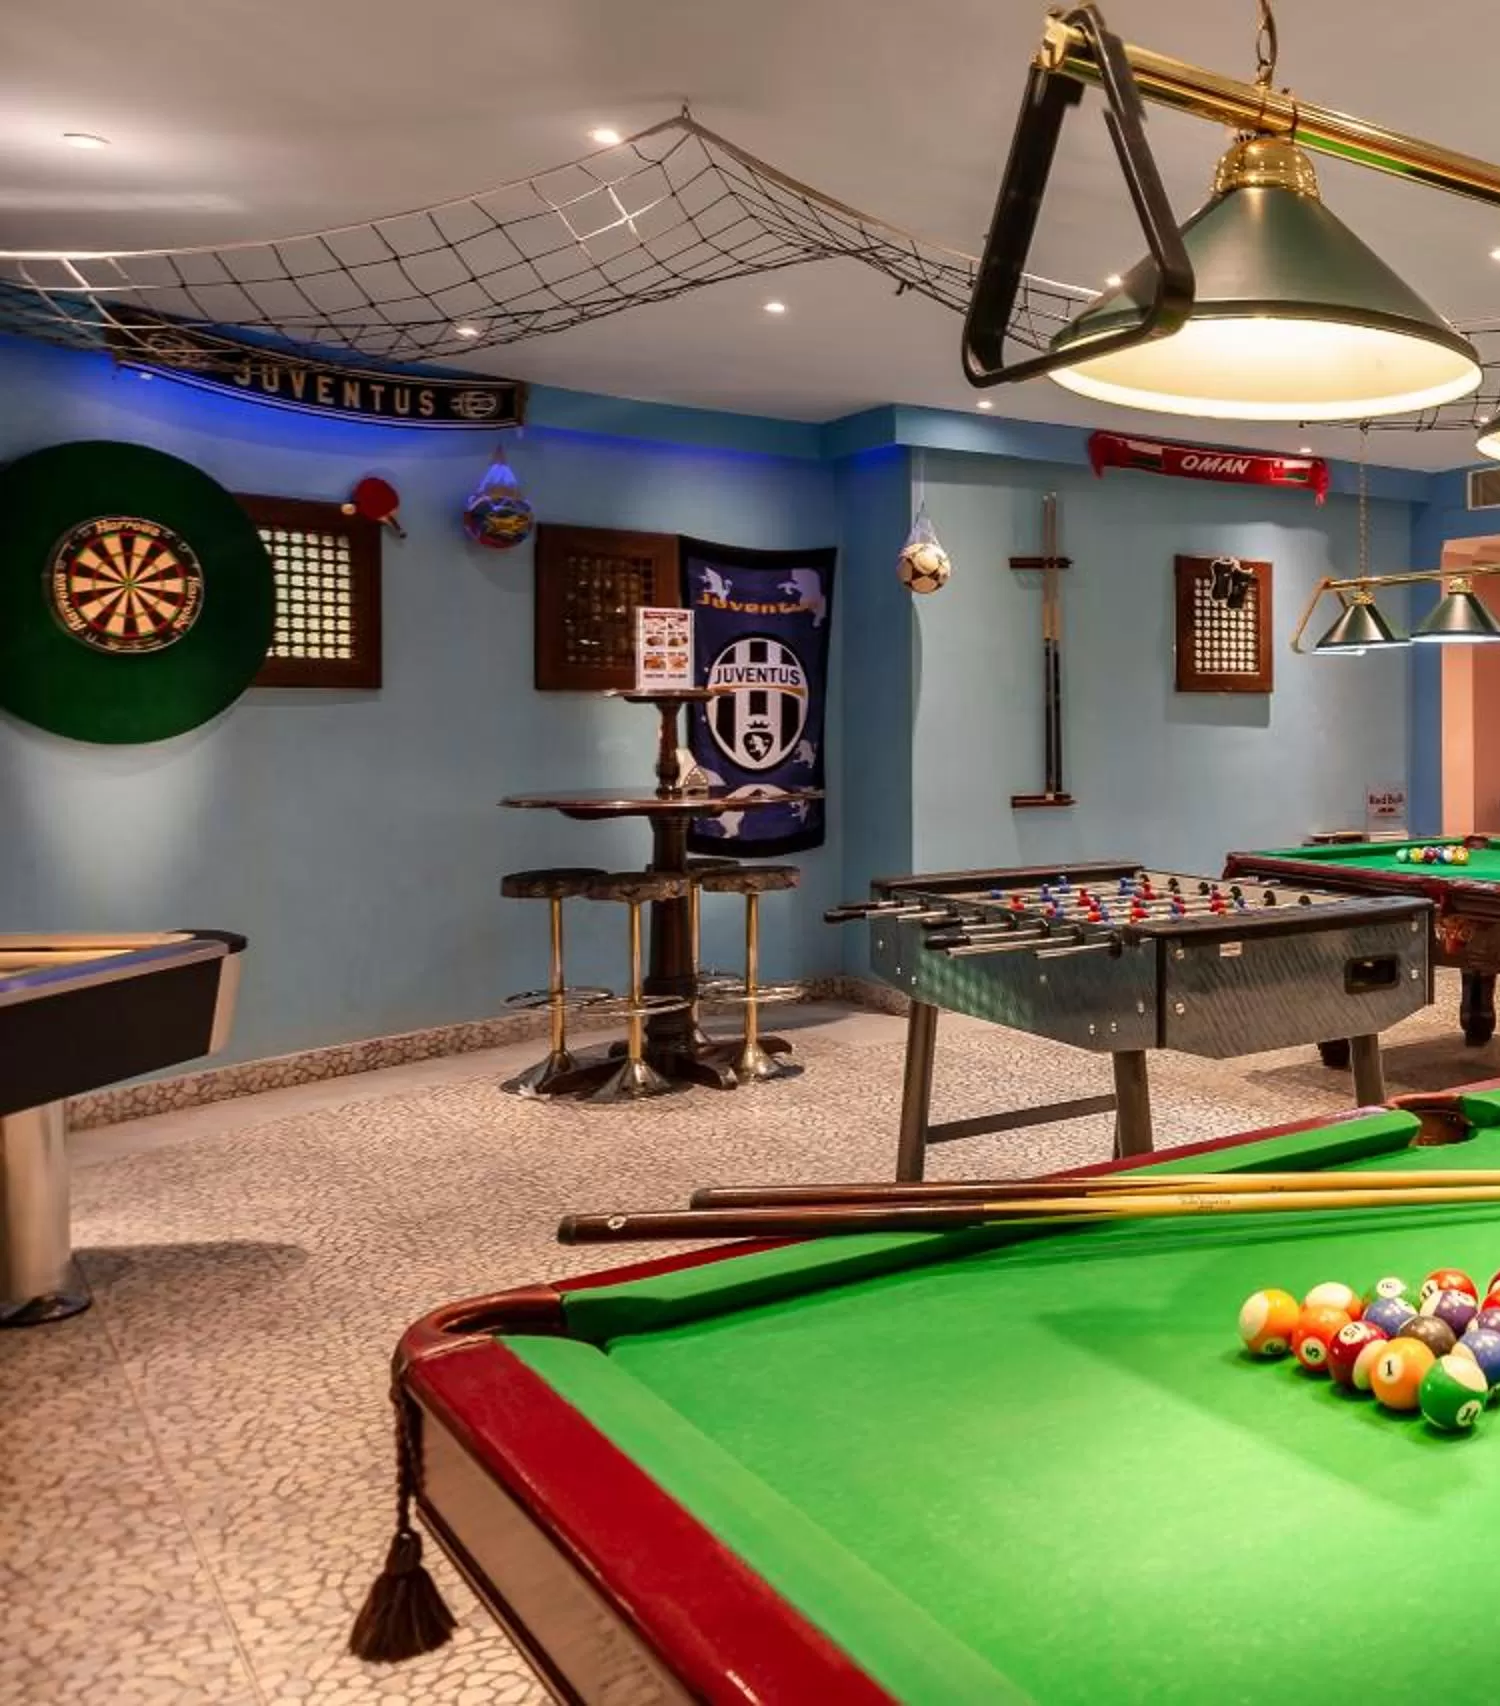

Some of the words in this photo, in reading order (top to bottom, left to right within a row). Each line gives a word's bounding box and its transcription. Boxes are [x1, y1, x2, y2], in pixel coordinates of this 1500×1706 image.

[234, 360, 435, 416] JUVENTUS
[1180, 454, 1250, 475] OMAN
[713, 667, 801, 685] JUVENTUS
[1385, 1360, 1394, 1377] 1
